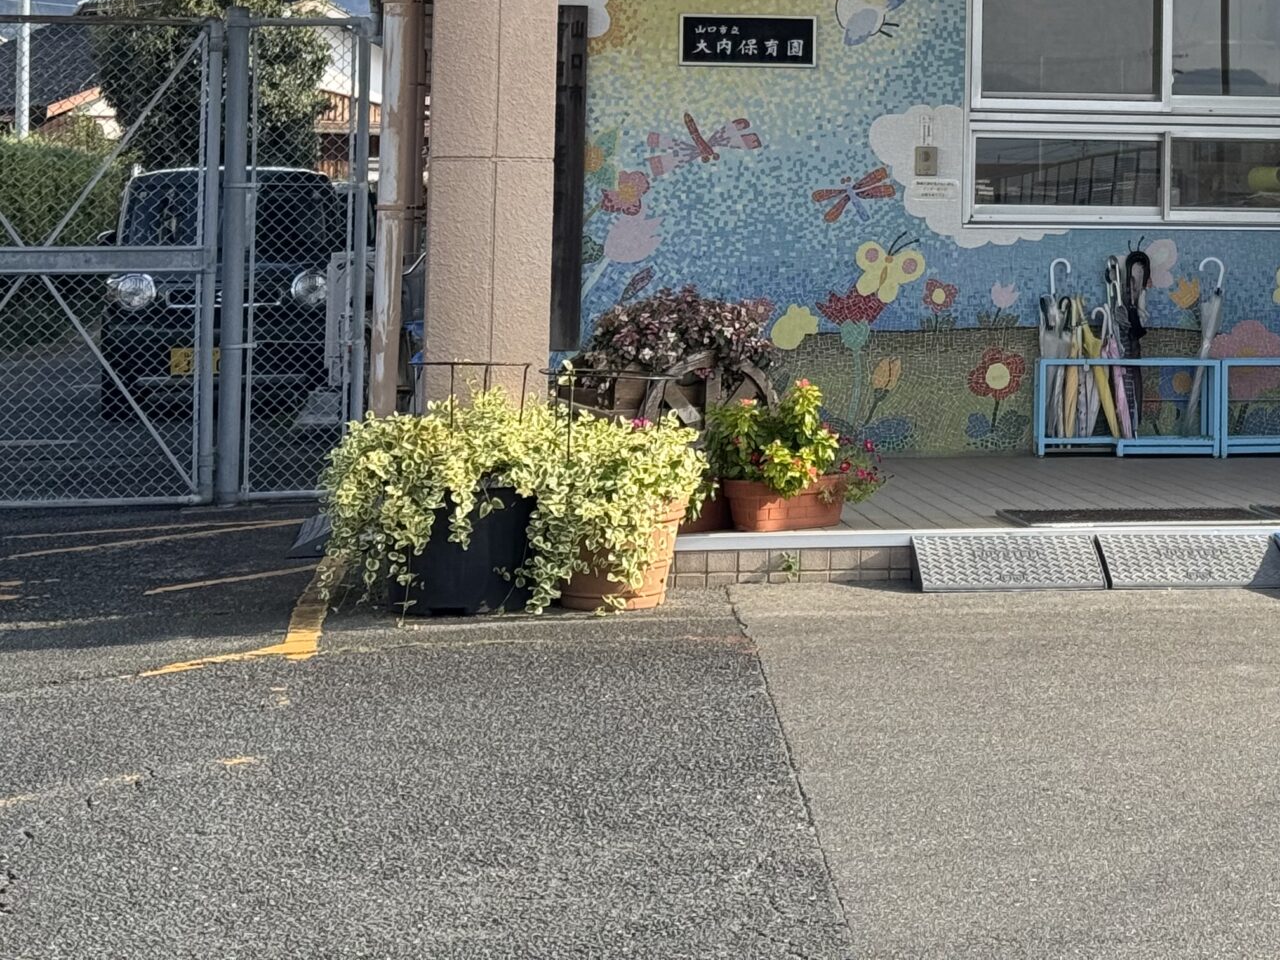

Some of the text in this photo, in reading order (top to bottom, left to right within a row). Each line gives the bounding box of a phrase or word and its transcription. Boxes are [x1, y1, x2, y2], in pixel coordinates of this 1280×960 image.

[692, 38, 804, 57] 大内保育園
